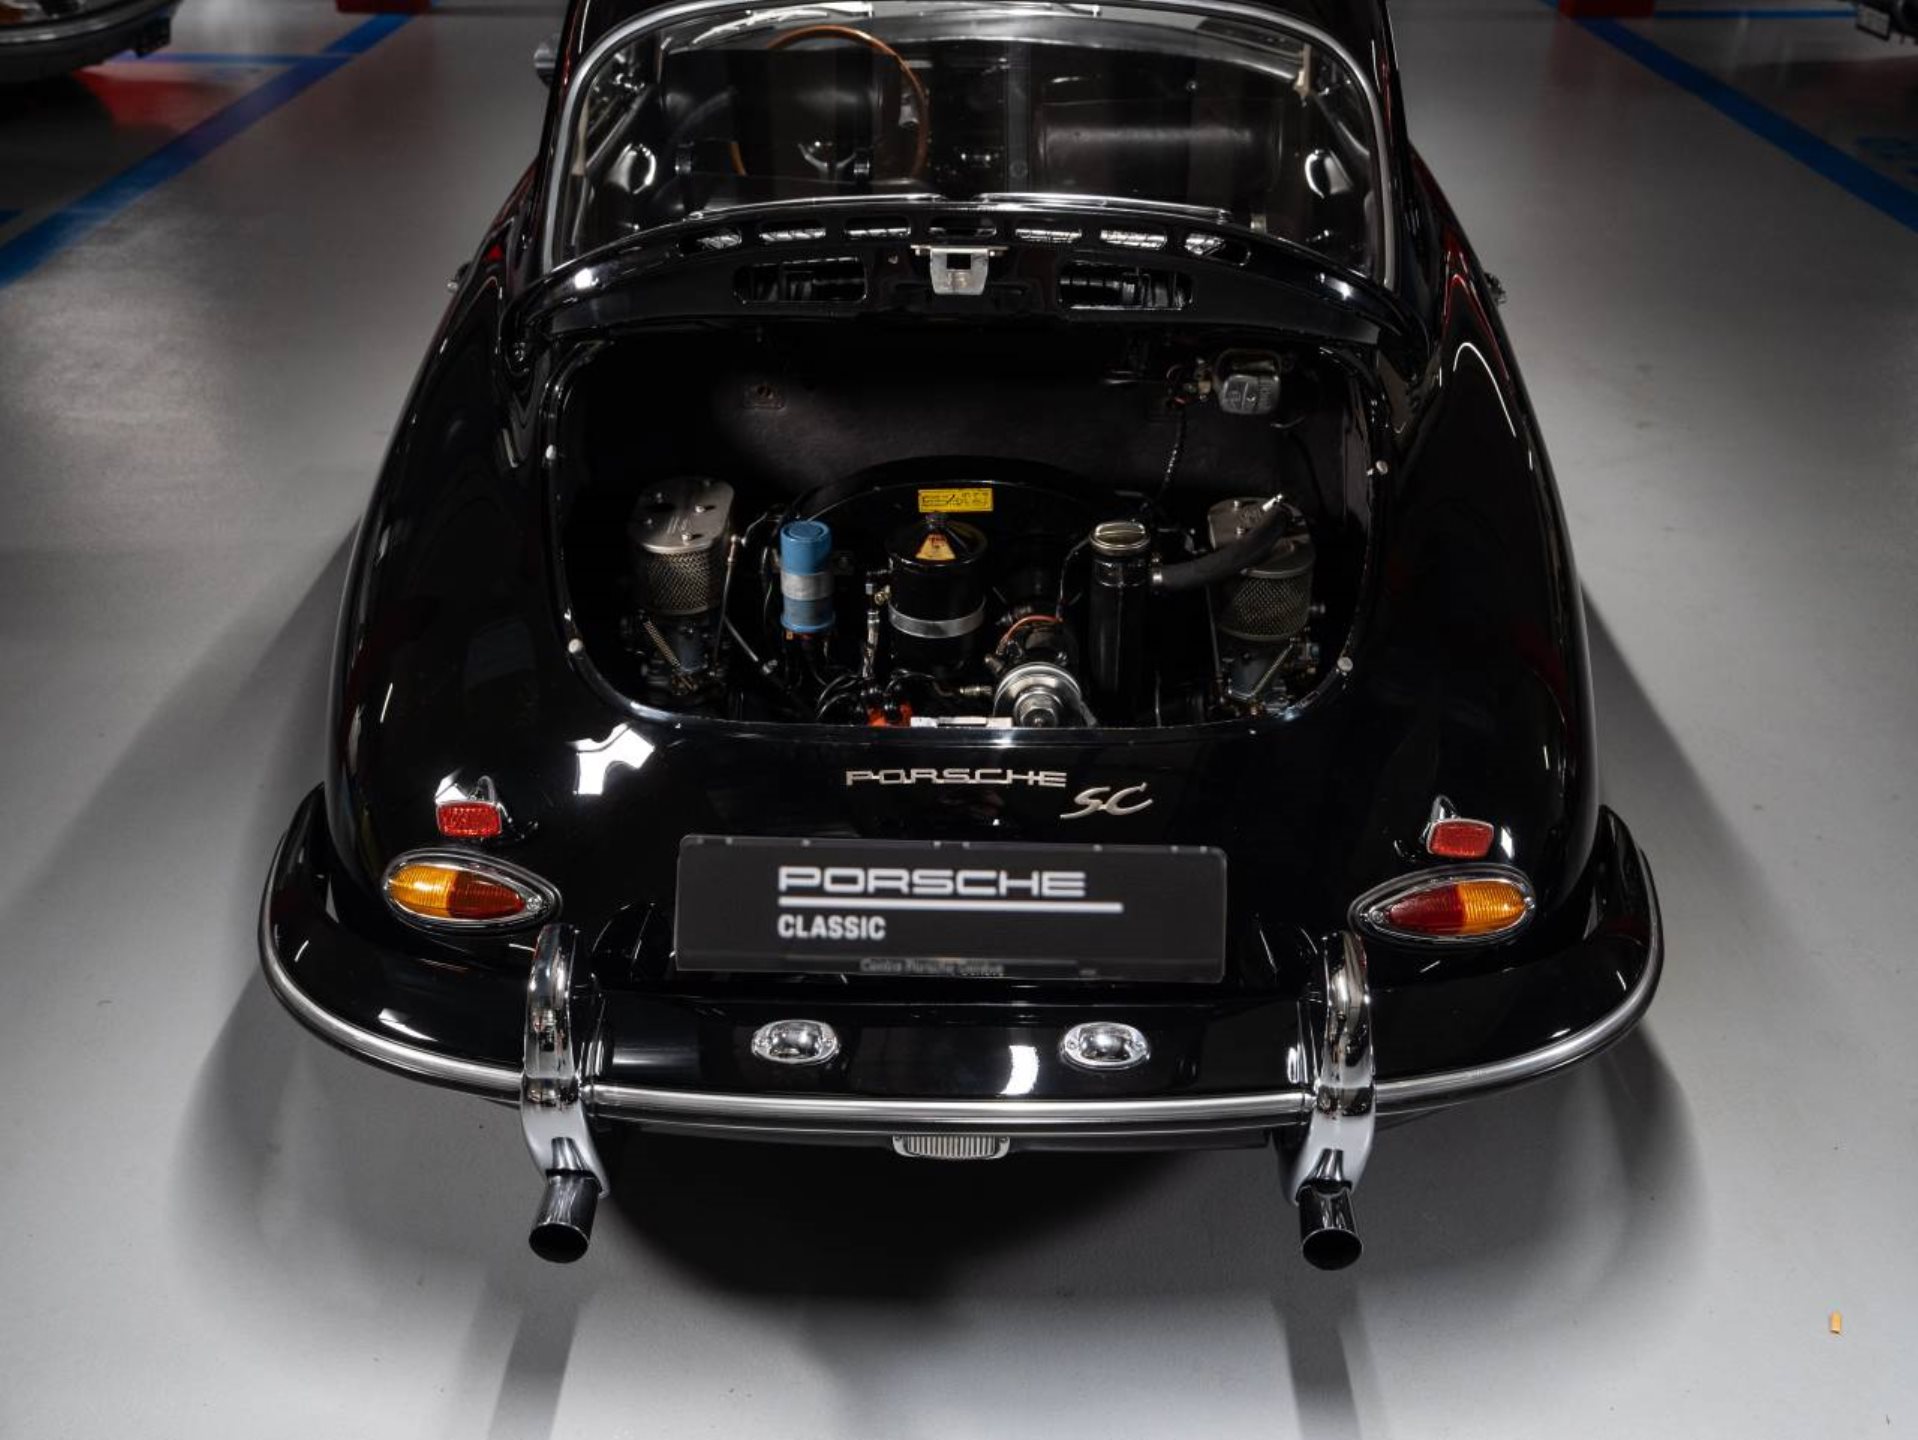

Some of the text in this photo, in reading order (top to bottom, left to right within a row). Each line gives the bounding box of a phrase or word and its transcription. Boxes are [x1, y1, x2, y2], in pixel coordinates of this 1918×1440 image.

[845, 768, 1067, 788] PORSCHE
[1056, 780, 1153, 819] SC
[777, 865, 1086, 899] PORSCHE
[777, 914, 886, 940] CLASSIC
